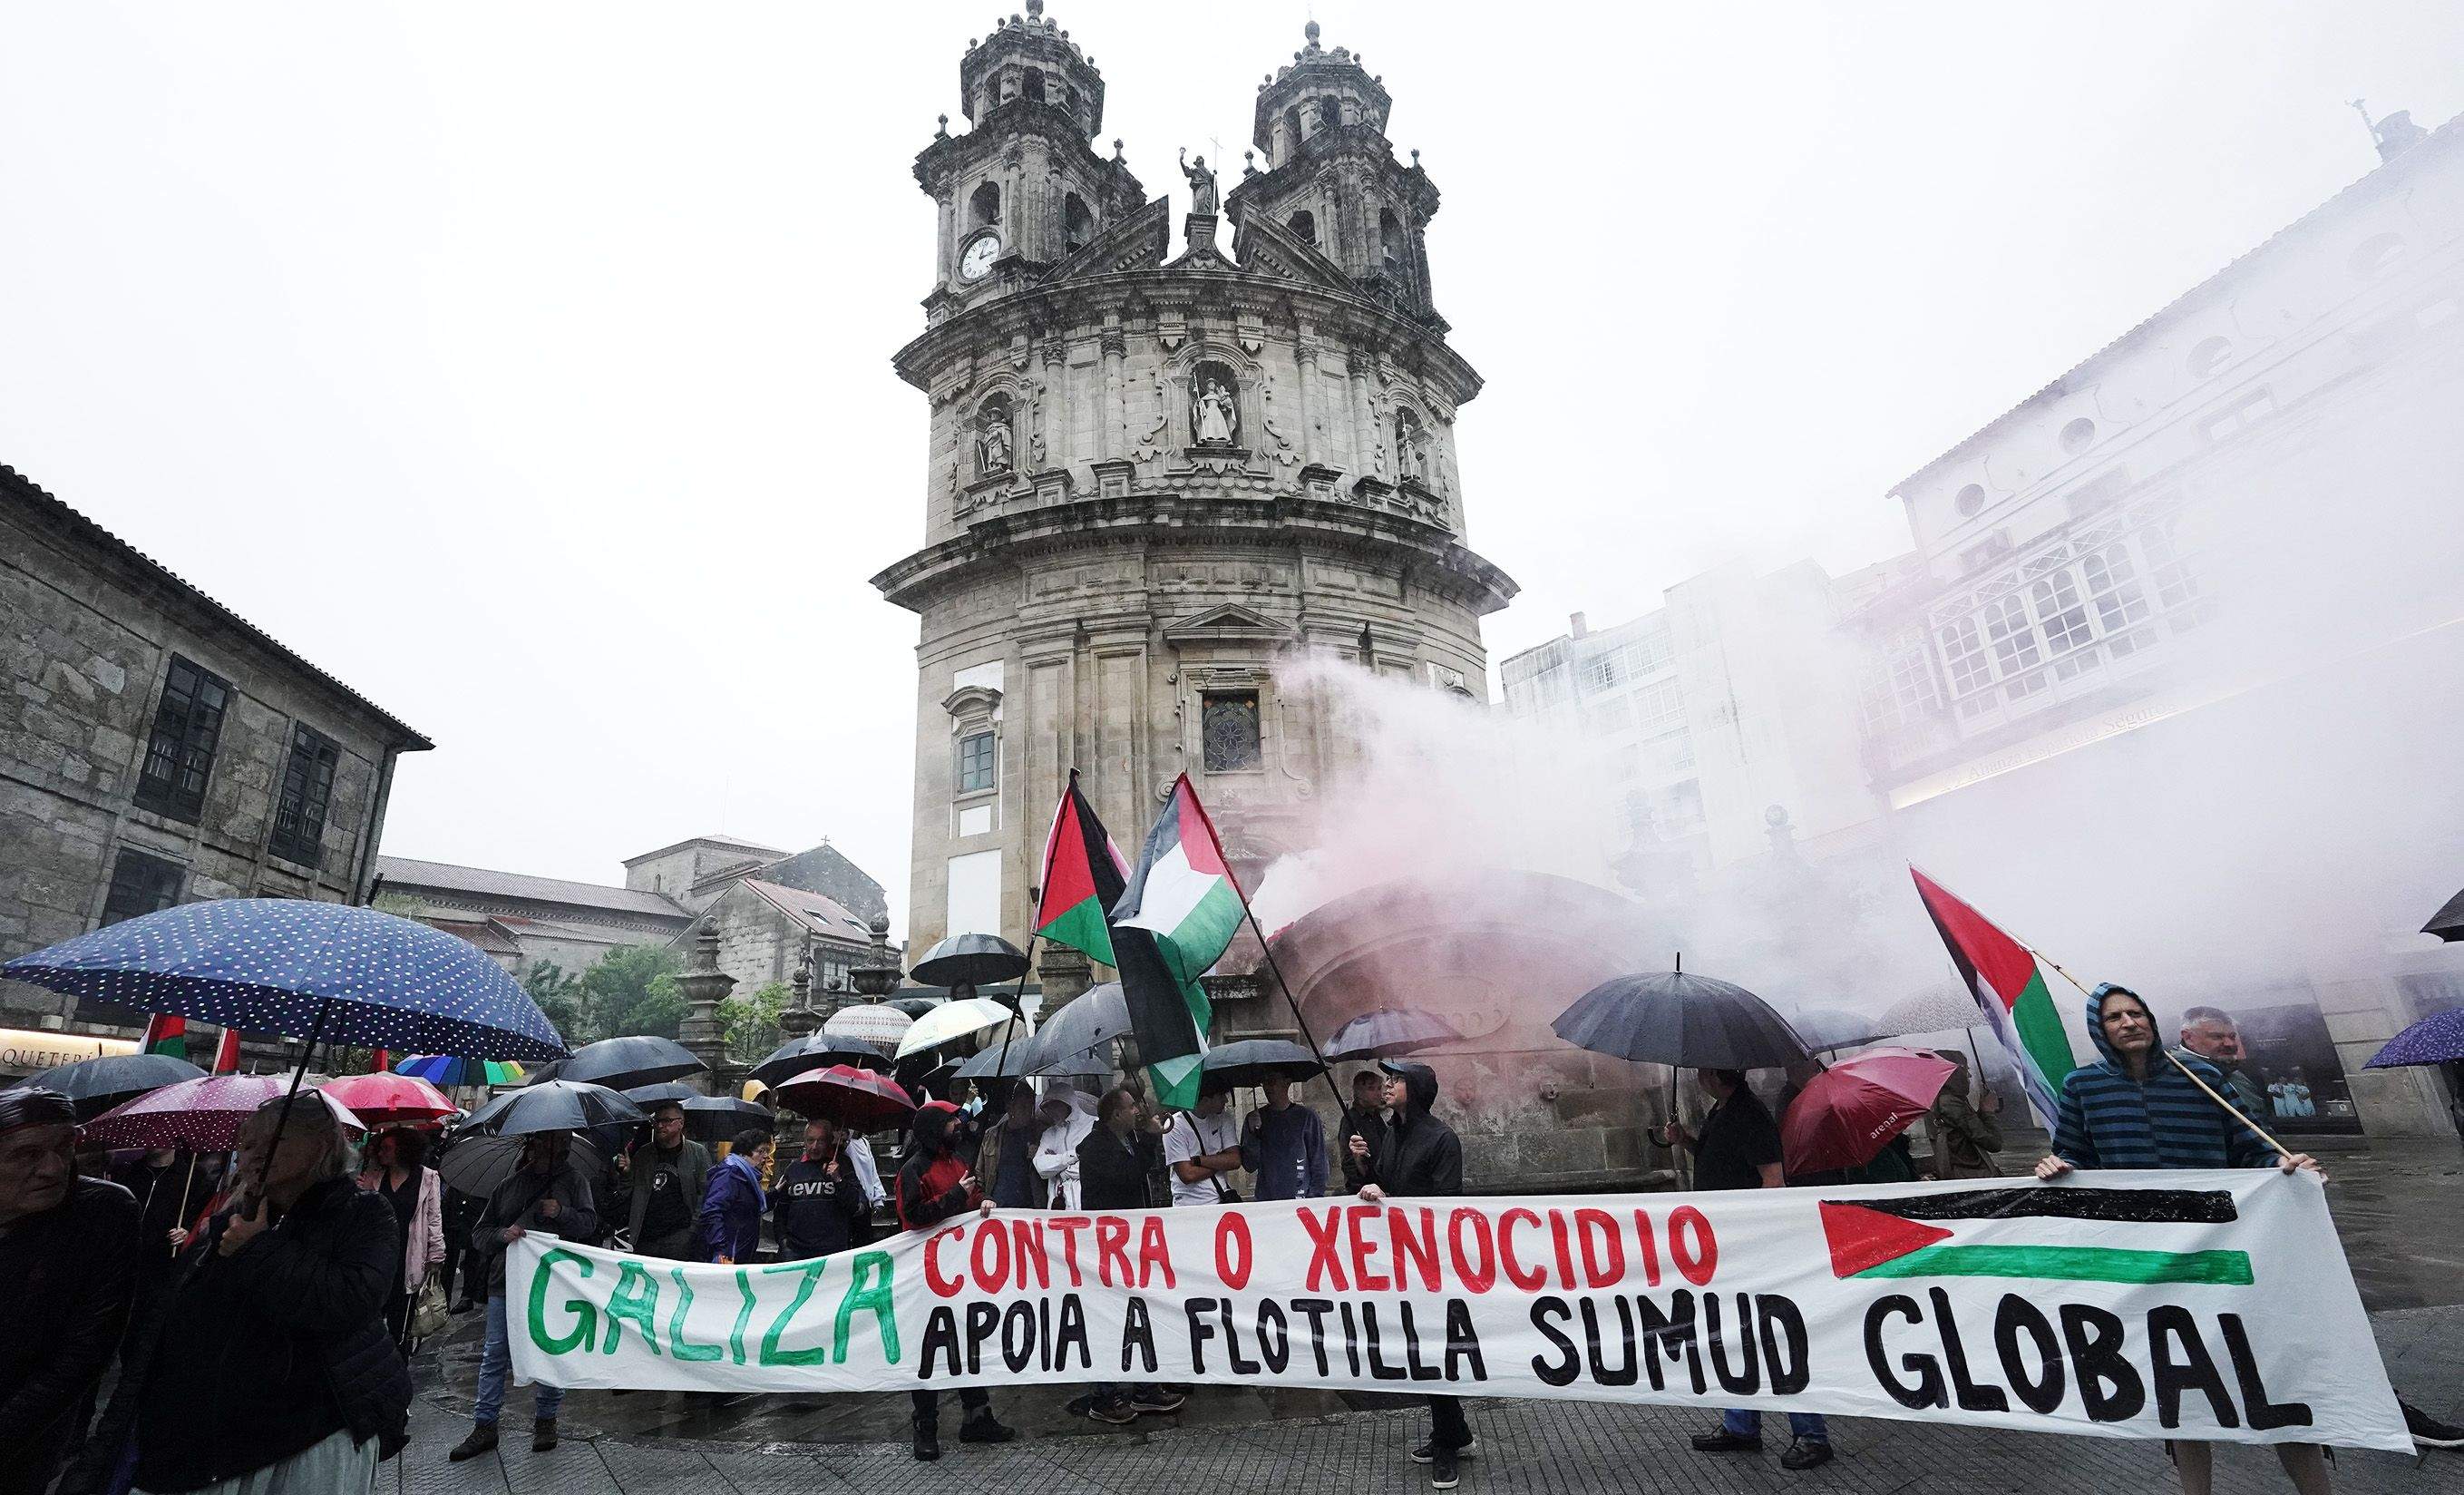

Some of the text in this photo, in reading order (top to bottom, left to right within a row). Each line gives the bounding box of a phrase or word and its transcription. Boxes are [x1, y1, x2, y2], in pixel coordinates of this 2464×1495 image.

[1870, 1111, 1898, 1139] arenal
[924, 1206, 1718, 1297] CONTRA O XENOCIDIO
[528, 1247, 901, 1366] GALIZA
[918, 1286, 2313, 1431] APOIA A FLOTILLA SUMUD GLOBAL
